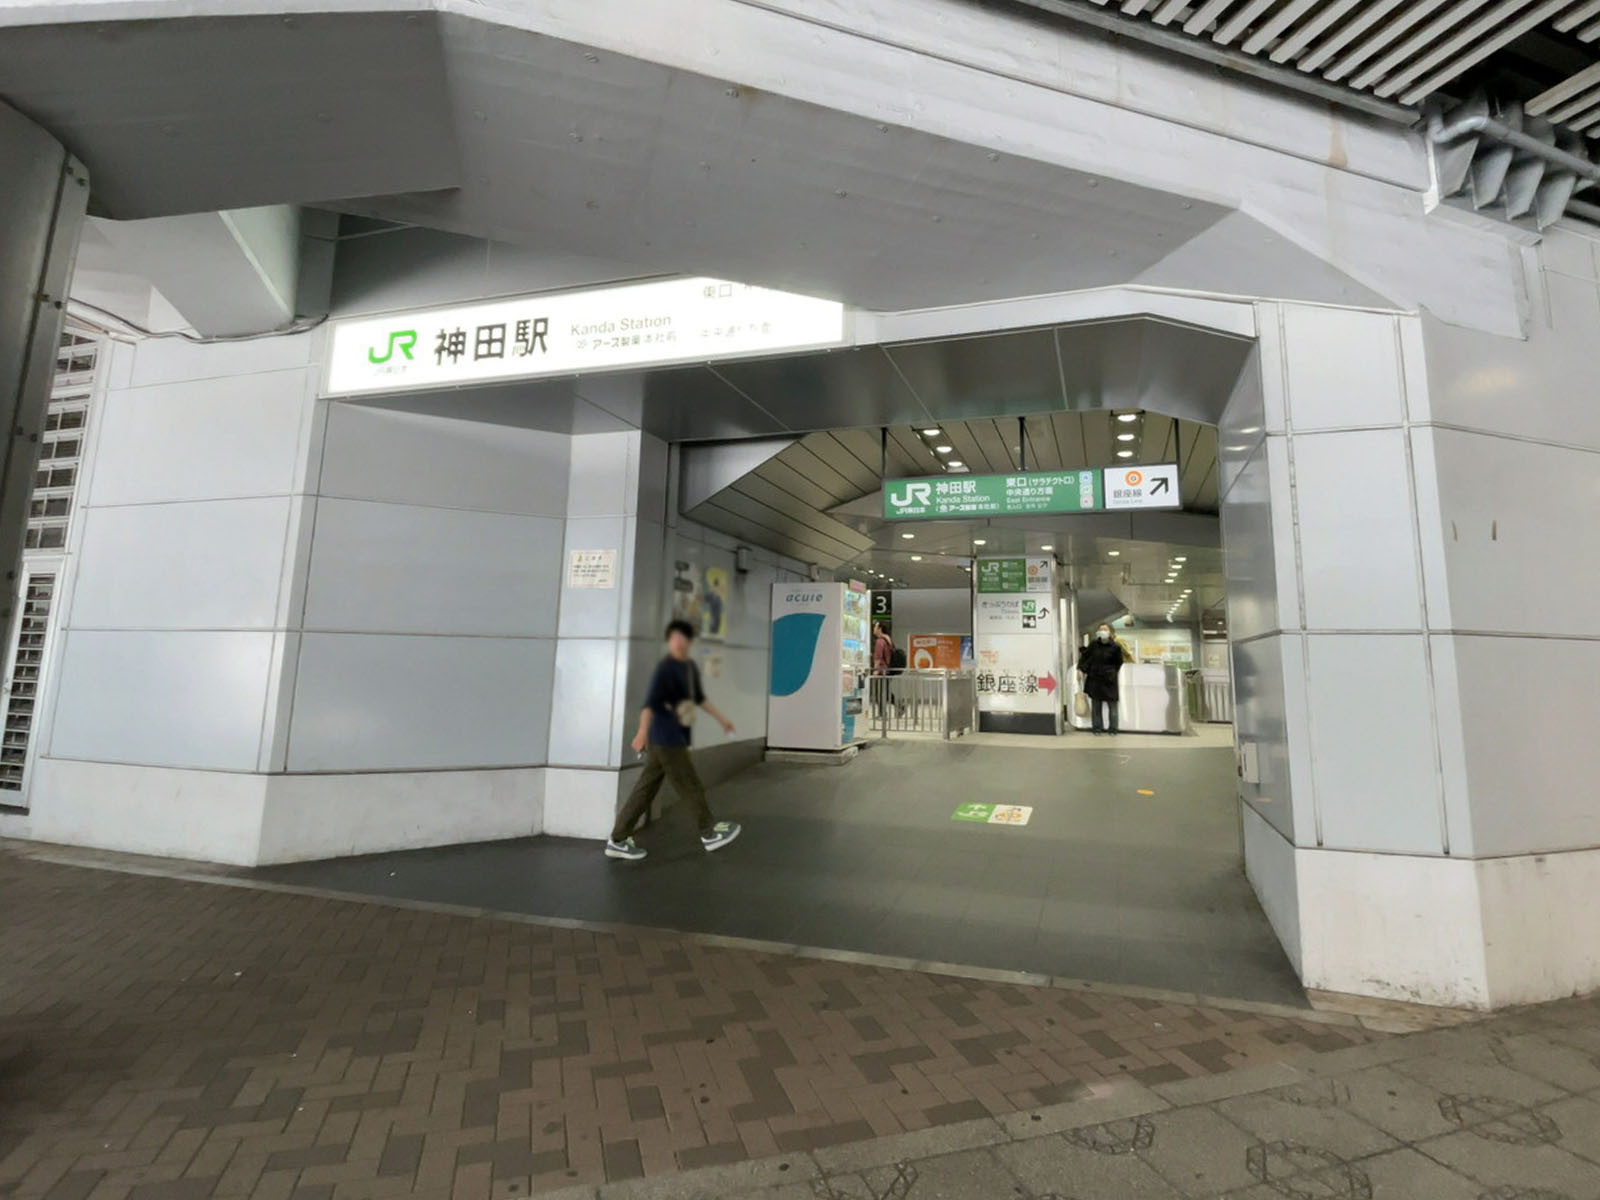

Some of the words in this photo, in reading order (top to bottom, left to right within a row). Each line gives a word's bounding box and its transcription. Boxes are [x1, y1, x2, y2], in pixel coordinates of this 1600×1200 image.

[570, 320, 615, 337] Kanda
[619, 314, 672, 331] Station
[368, 329, 417, 364] JR
[434, 316, 549, 367] 神田駅
[890, 482, 931, 507] JR
[936, 480, 976, 496] 神田駅
[962, 494, 990, 504] Station
[875, 596, 887, 613] 3
[976, 673, 1039, 694] 銀座線
